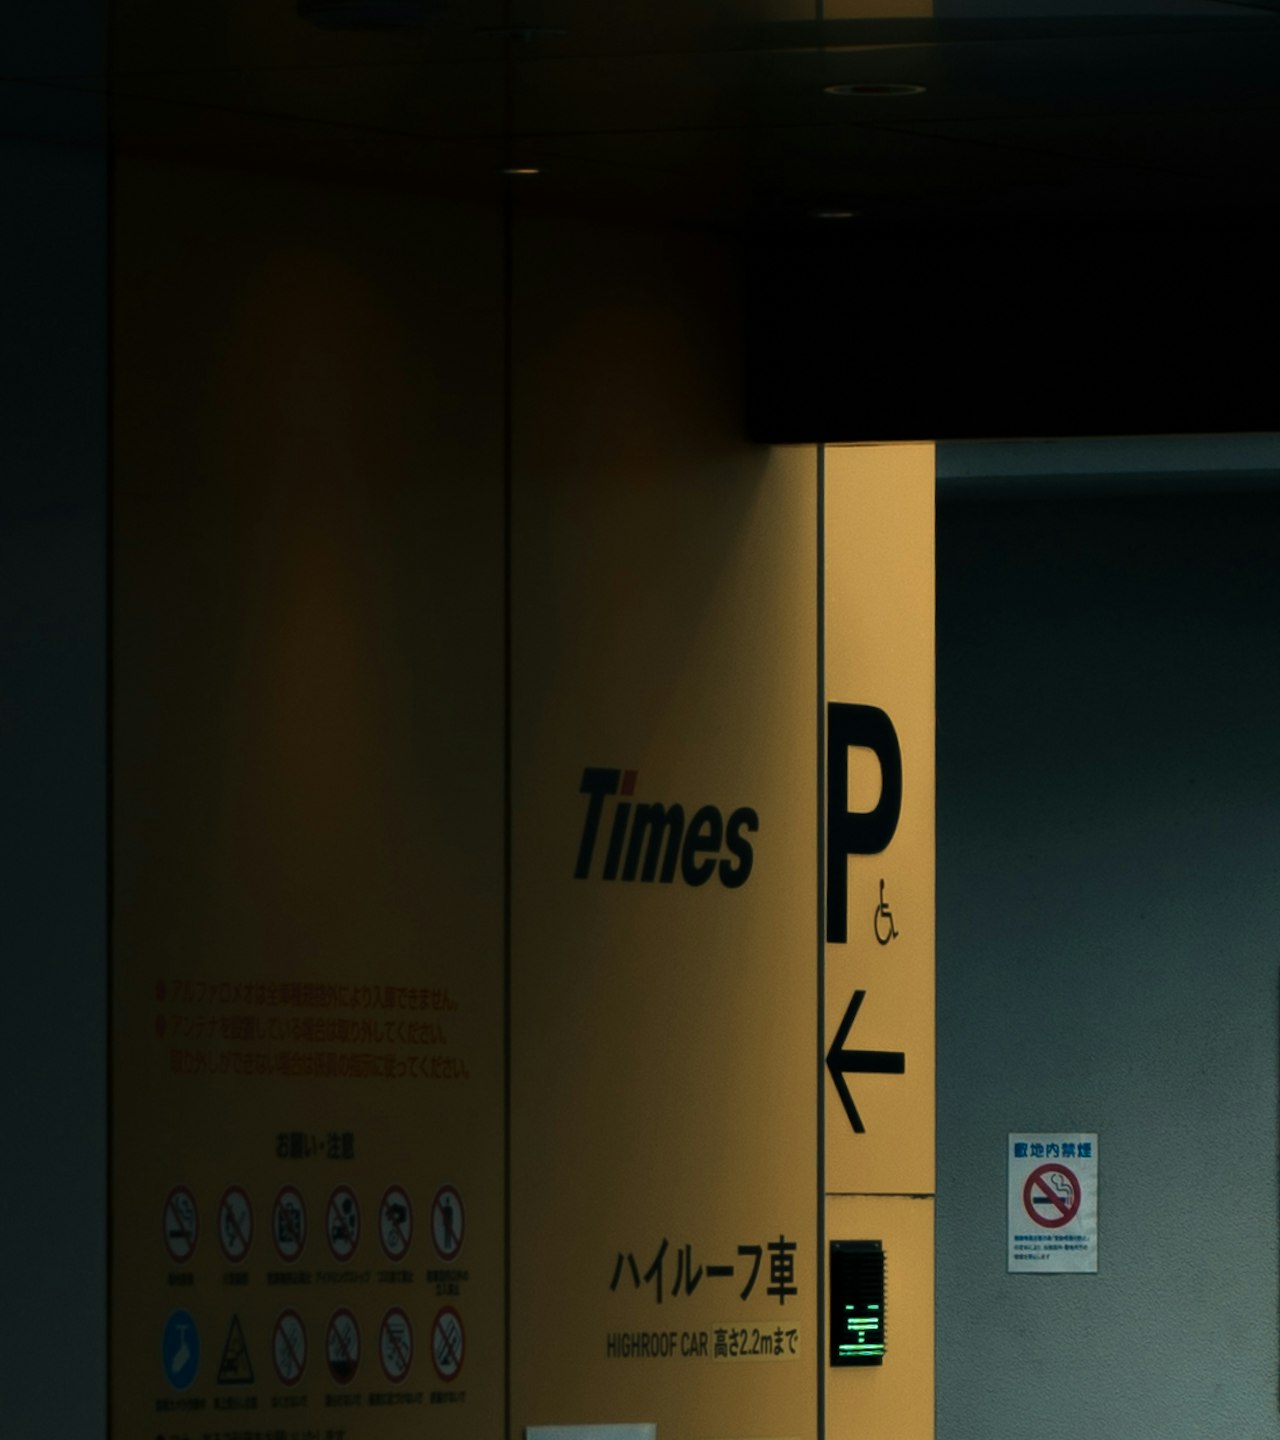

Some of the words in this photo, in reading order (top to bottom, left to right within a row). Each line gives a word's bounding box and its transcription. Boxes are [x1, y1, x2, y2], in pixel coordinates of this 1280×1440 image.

[574, 767, 759, 888] Times
[827, 702, 902, 943] P
[276, 1131, 354, 1160] お願い・注意
[1014, 1142, 1092, 1158] 敷地内禁煙
[609, 1235, 797, 1305] ハイルーフ車
[608, 1332, 677, 1359] HIGHROOF
[681, 1331, 708, 1356] CAR
[713, 1328, 799, 1358] 高さ2.2mまで
